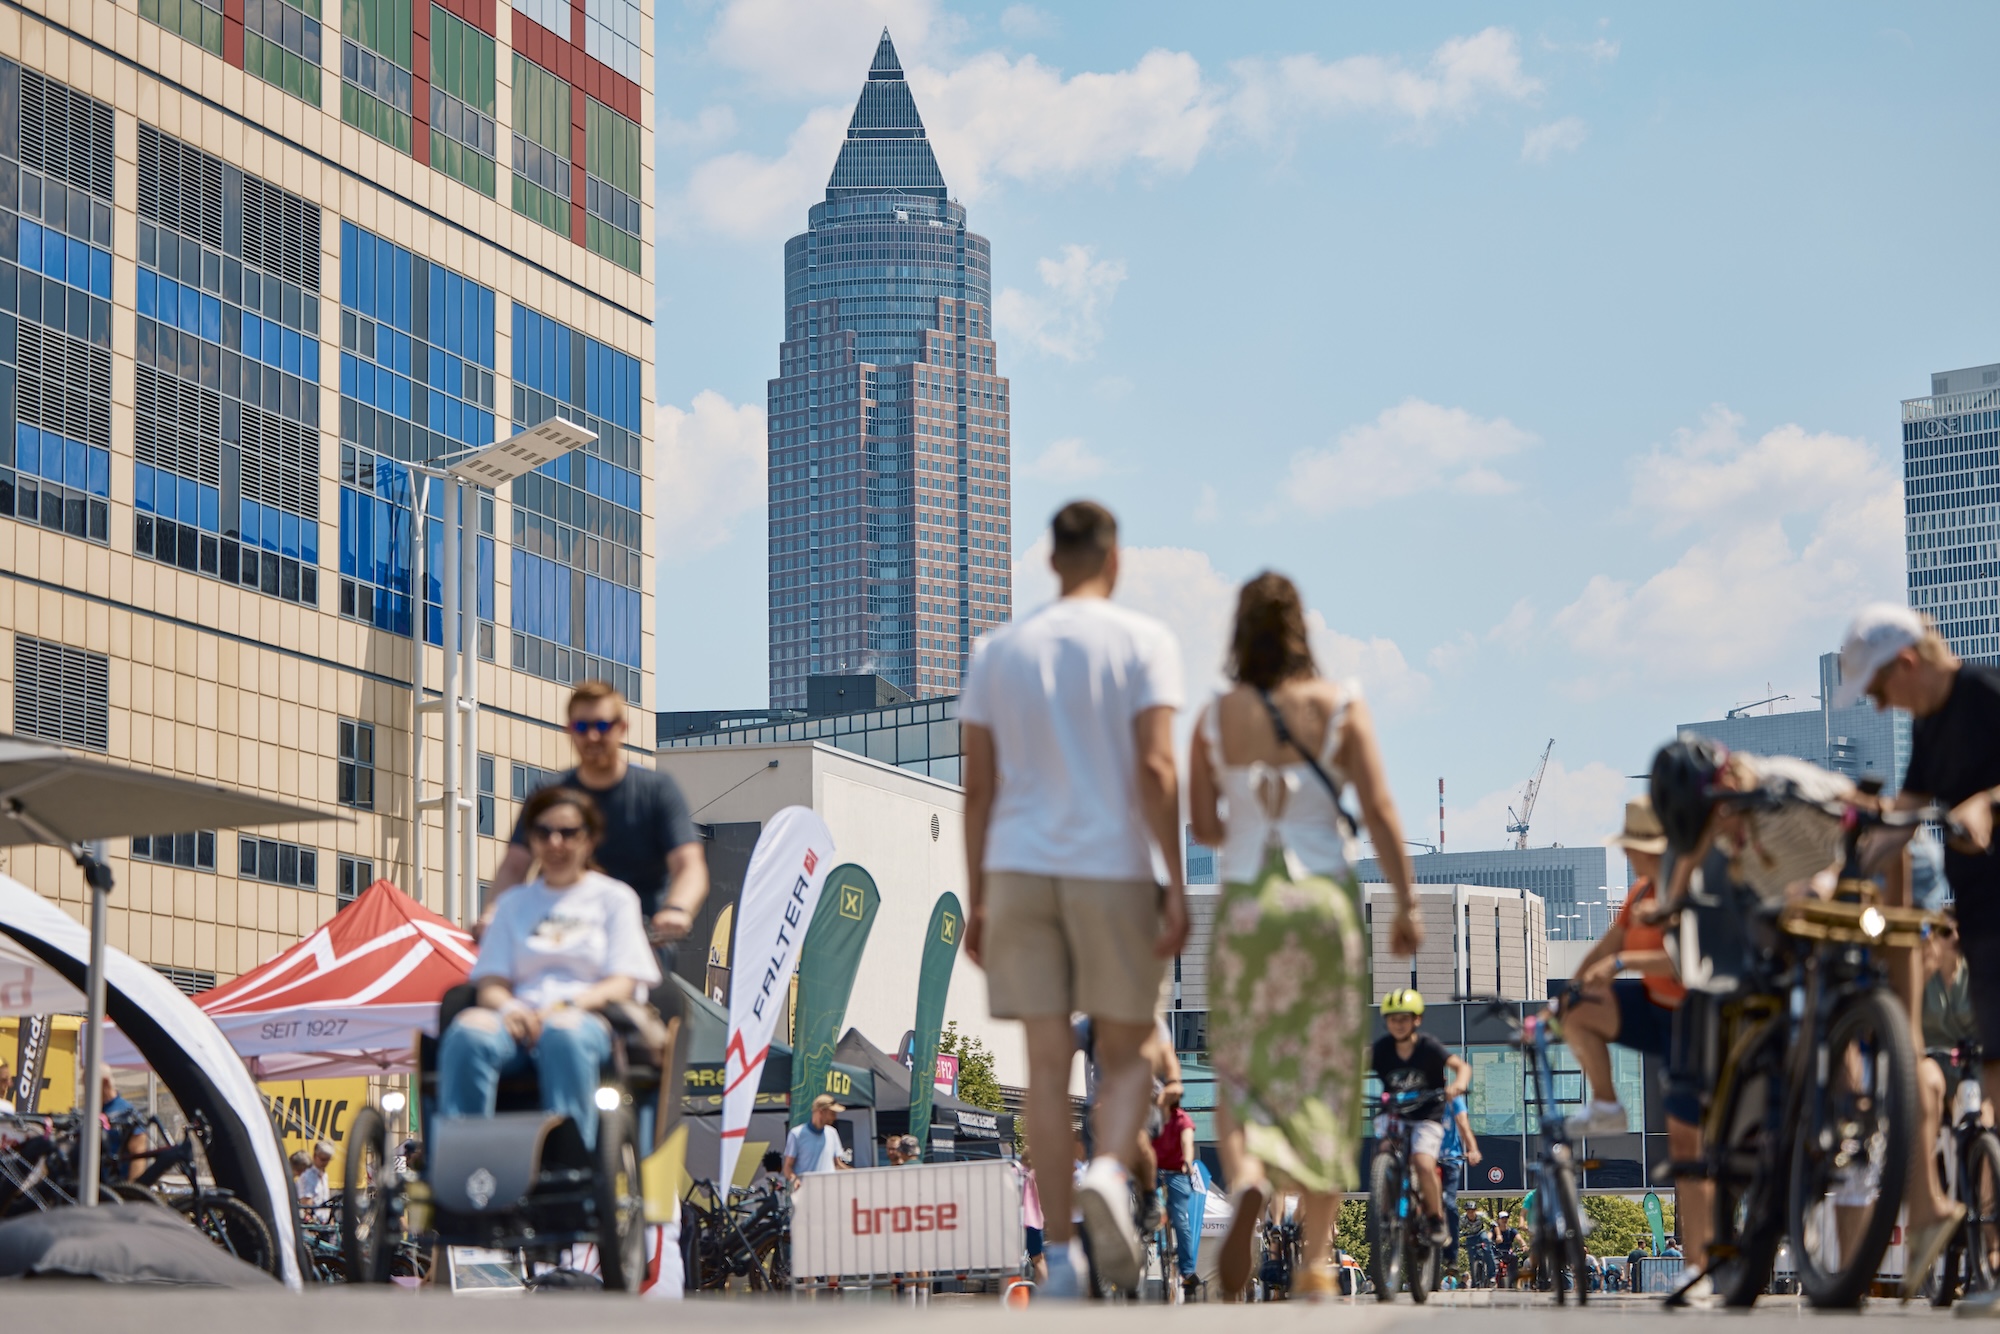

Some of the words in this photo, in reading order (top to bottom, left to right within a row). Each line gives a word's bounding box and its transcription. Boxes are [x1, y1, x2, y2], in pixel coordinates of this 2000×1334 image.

[1924, 416, 1958, 437] ONE
[753, 875, 809, 1021] FALTER
[261, 1022, 301, 1040] SEIT
[306, 1019, 348, 1037] 1927
[262, 1095, 349, 1142] MAVIC
[852, 1198, 958, 1235] brose
